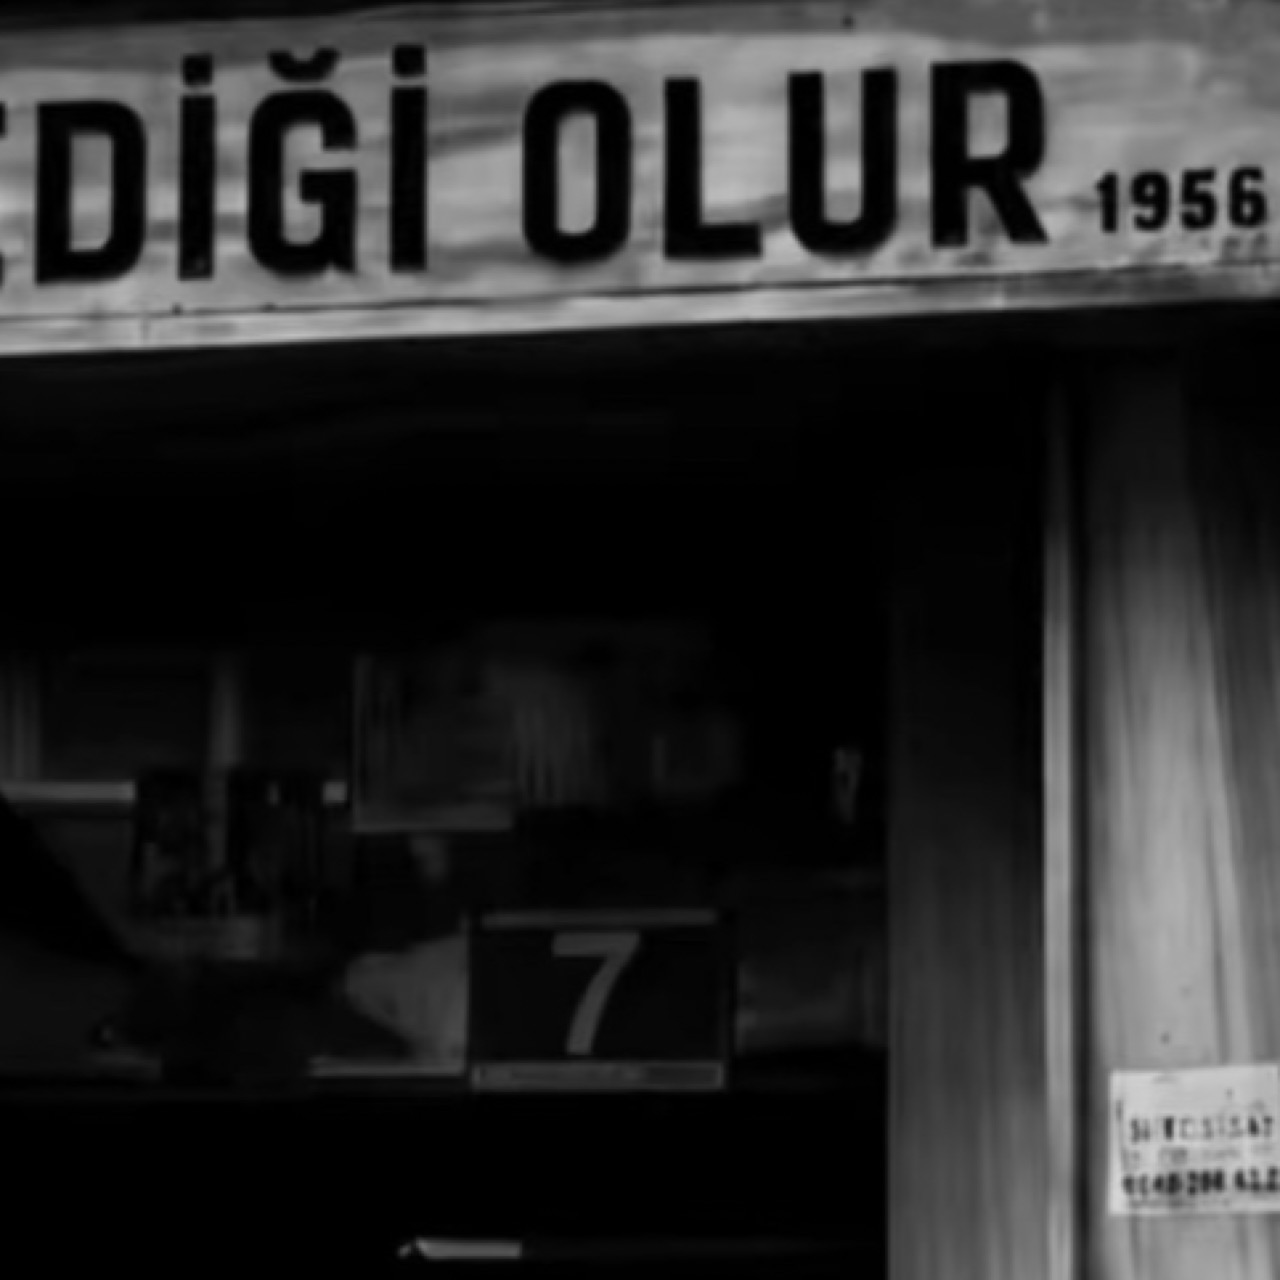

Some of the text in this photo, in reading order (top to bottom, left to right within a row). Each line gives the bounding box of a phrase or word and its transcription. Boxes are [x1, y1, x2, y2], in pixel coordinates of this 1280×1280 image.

[522, 59, 1049, 271] OLUR
[1096, 166, 1269, 233] 1956
[551, 931, 641, 1056] 7
